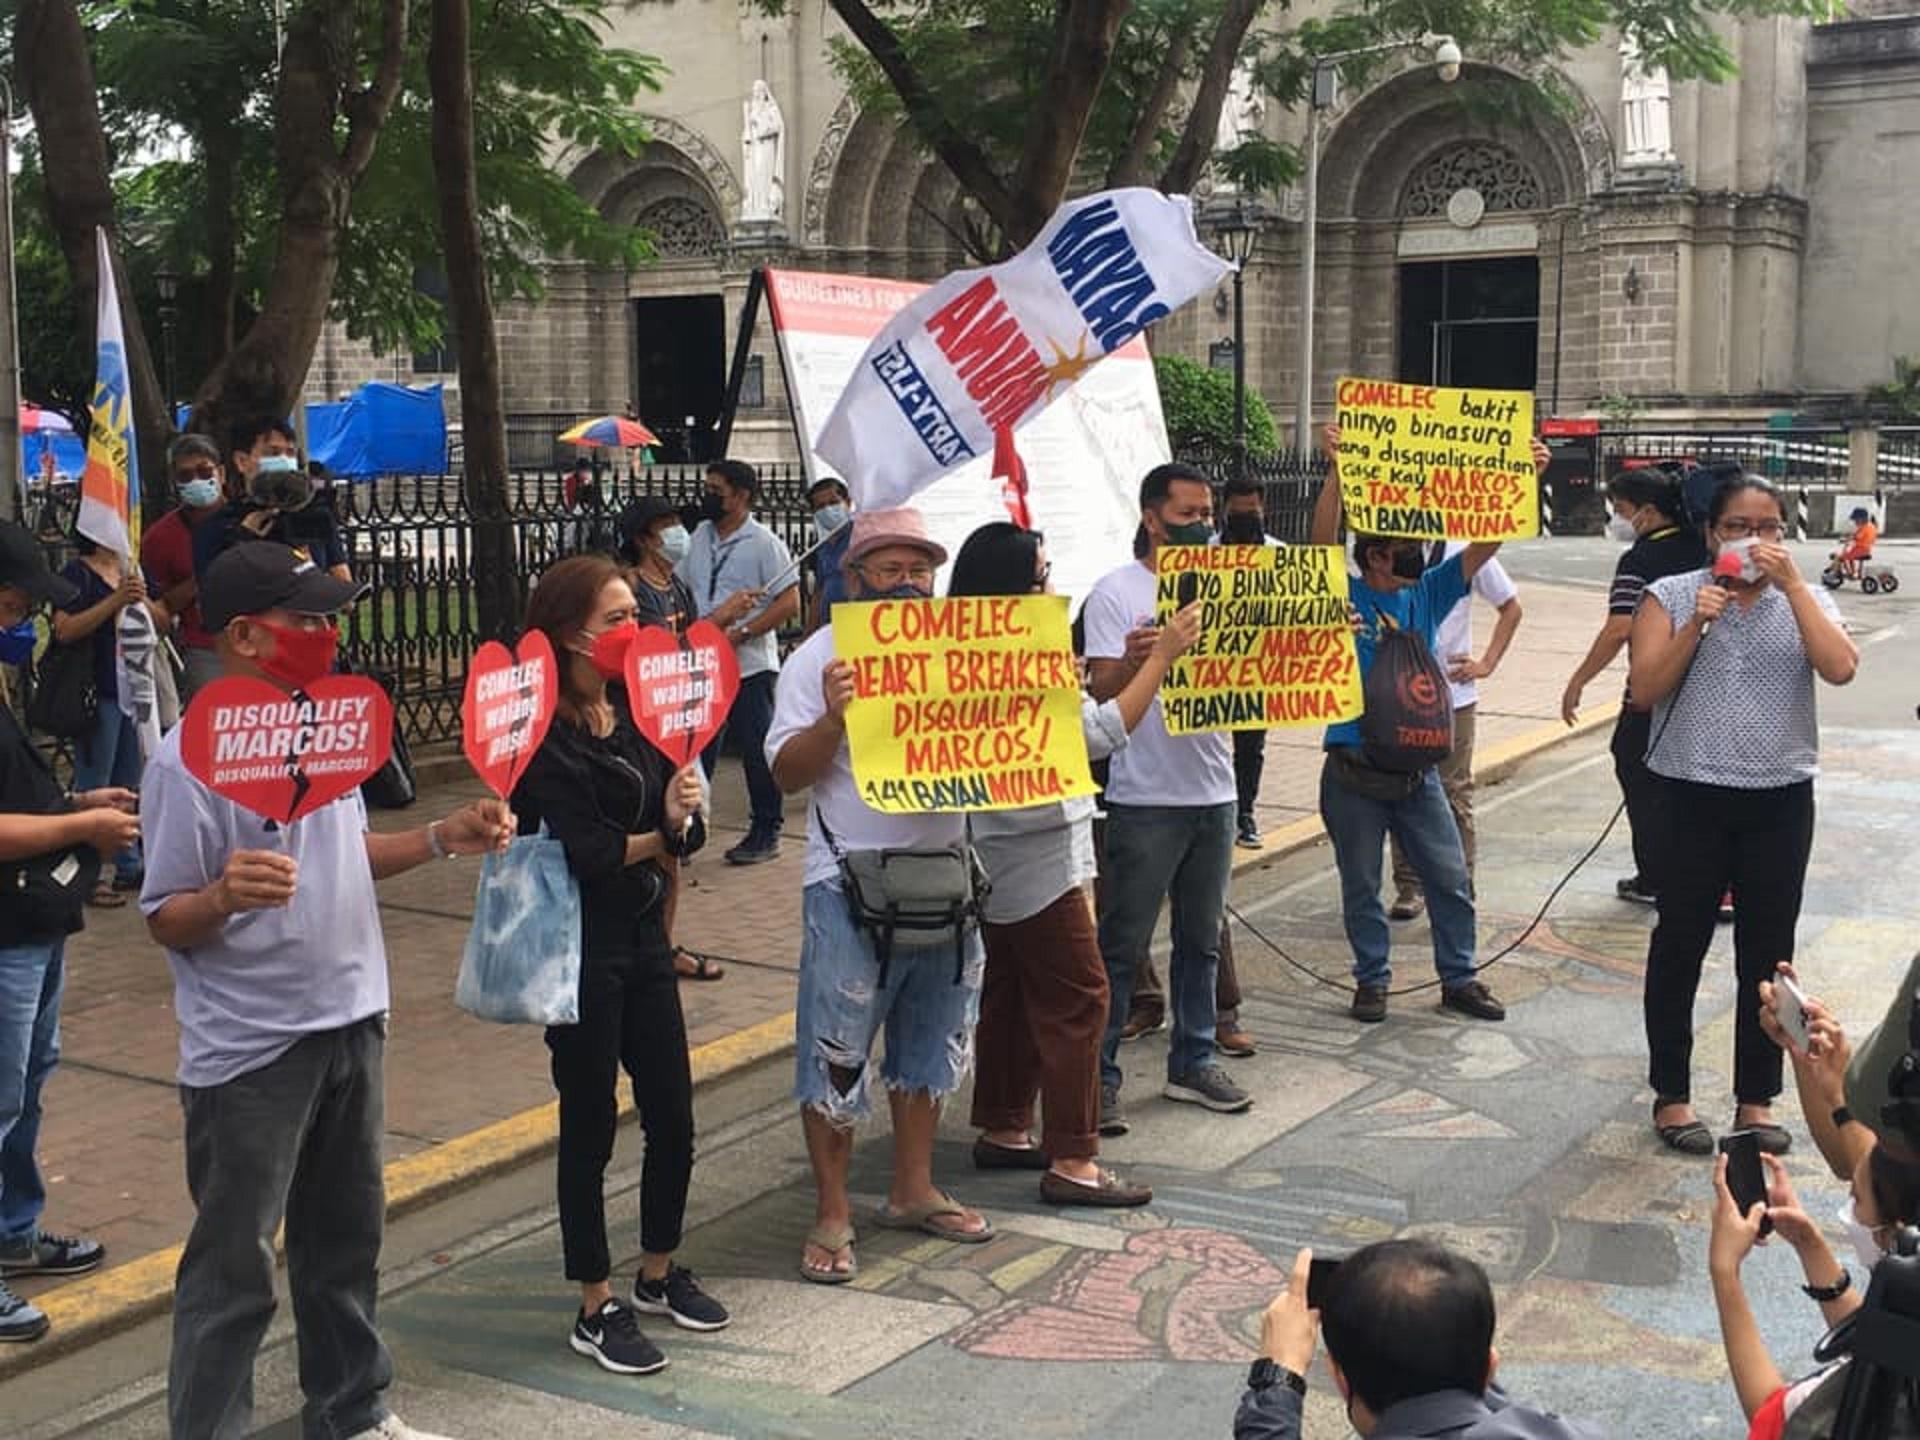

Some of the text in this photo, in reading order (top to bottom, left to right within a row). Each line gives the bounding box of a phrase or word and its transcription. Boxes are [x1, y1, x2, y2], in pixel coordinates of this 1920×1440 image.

[1339, 380, 1519, 423] COMELEC bakit
[1339, 411, 1512, 446] ninyo binasura
[1379, 440, 1534, 474] disqualification
[1366, 481, 1409, 506] TAX
[1420, 487, 1526, 512] EVADER!
[1160, 546, 1329, 573] COMELEC BAKIT
[1157, 569, 1329, 601] NYO BINASURA
[1201, 598, 1349, 630] DISQUALIFICATION
[1216, 630, 1258, 655] KAY
[1261, 627, 1345, 657] MARCOS
[945, 649, 1077, 695] BREAKER!
[1191, 656, 1235, 688] TAX
[1237, 654, 1354, 687] EVADER!
[653, 679, 714, 705] walang
[214, 697, 369, 731] DISQUALIFY
[660, 701, 709, 738] puso!
[893, 694, 1045, 737] DISQUALIFY
[216, 722, 369, 763] MARCOS!
[904, 717, 1051, 775] MARCOS!
[214, 757, 368, 784] DISQUALIFY MARCOS!
